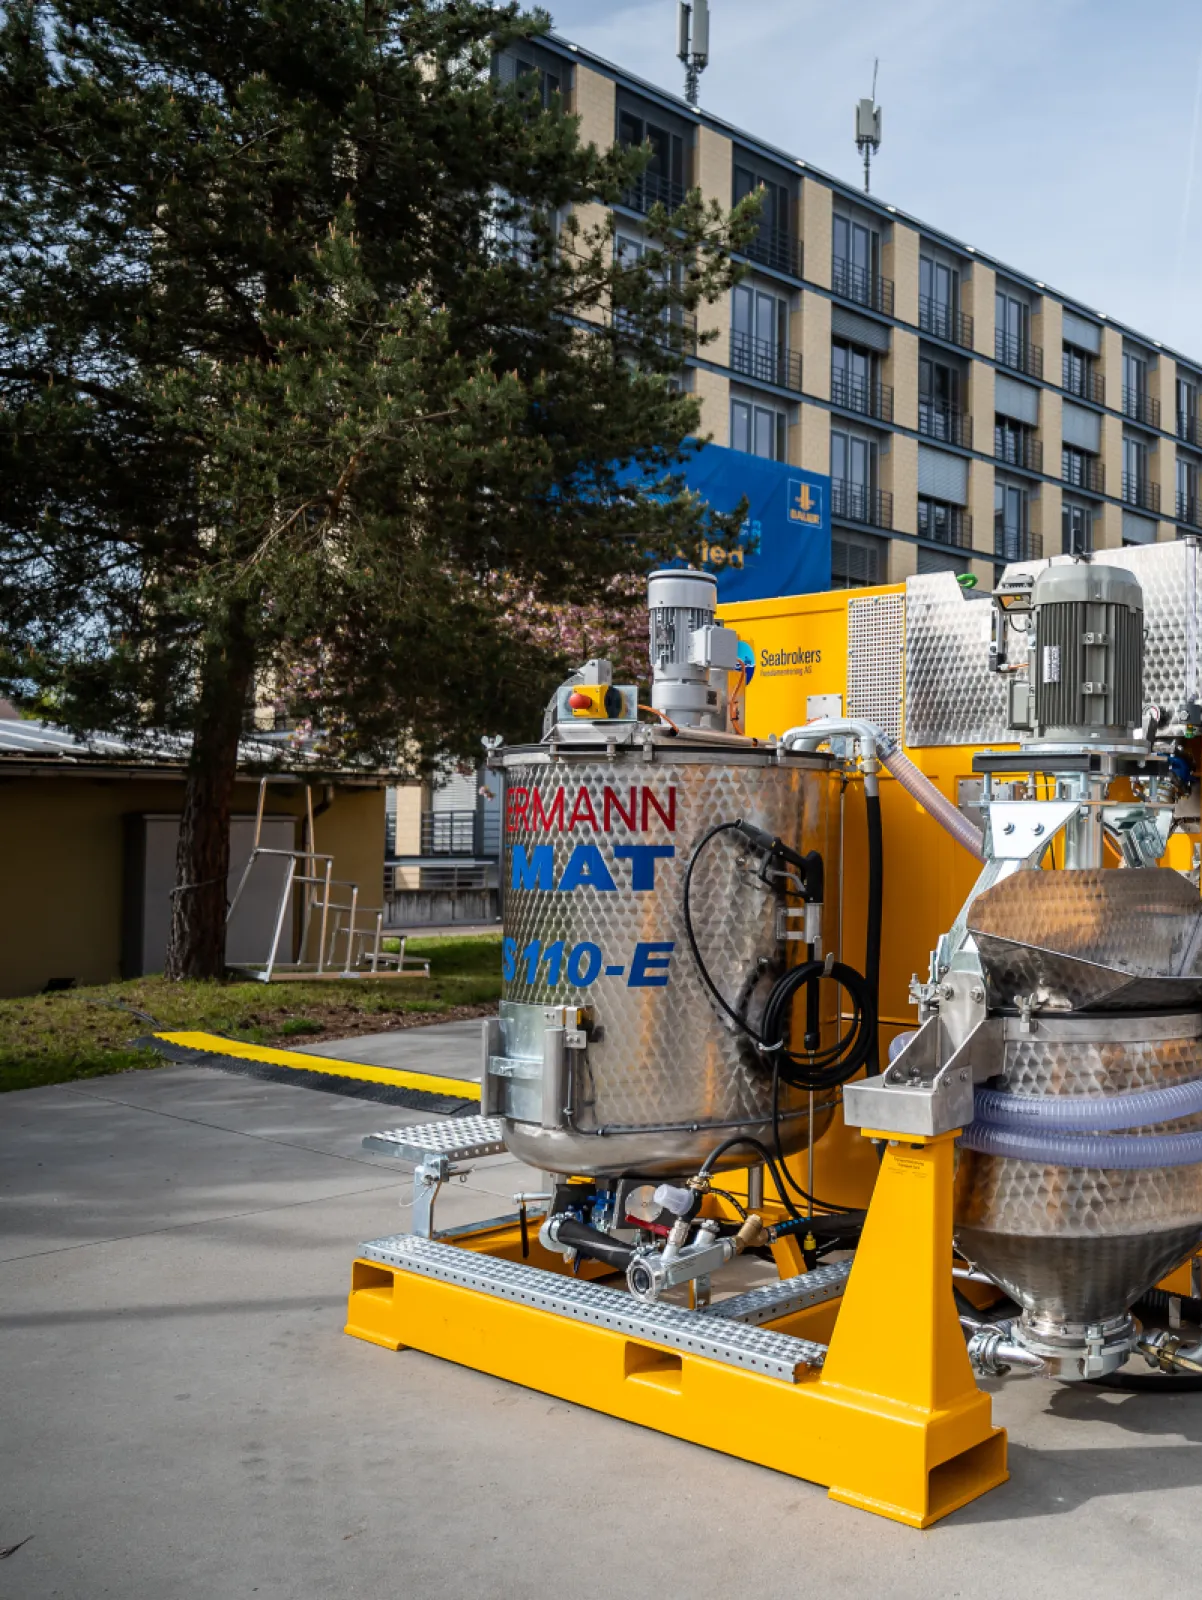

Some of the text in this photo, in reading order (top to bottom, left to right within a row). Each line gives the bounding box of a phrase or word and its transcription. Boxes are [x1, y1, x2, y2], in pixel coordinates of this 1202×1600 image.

[760, 646, 822, 667] Seabrokers
[506, 786, 676, 832] ERMANN
[505, 844, 675, 891] MAT
